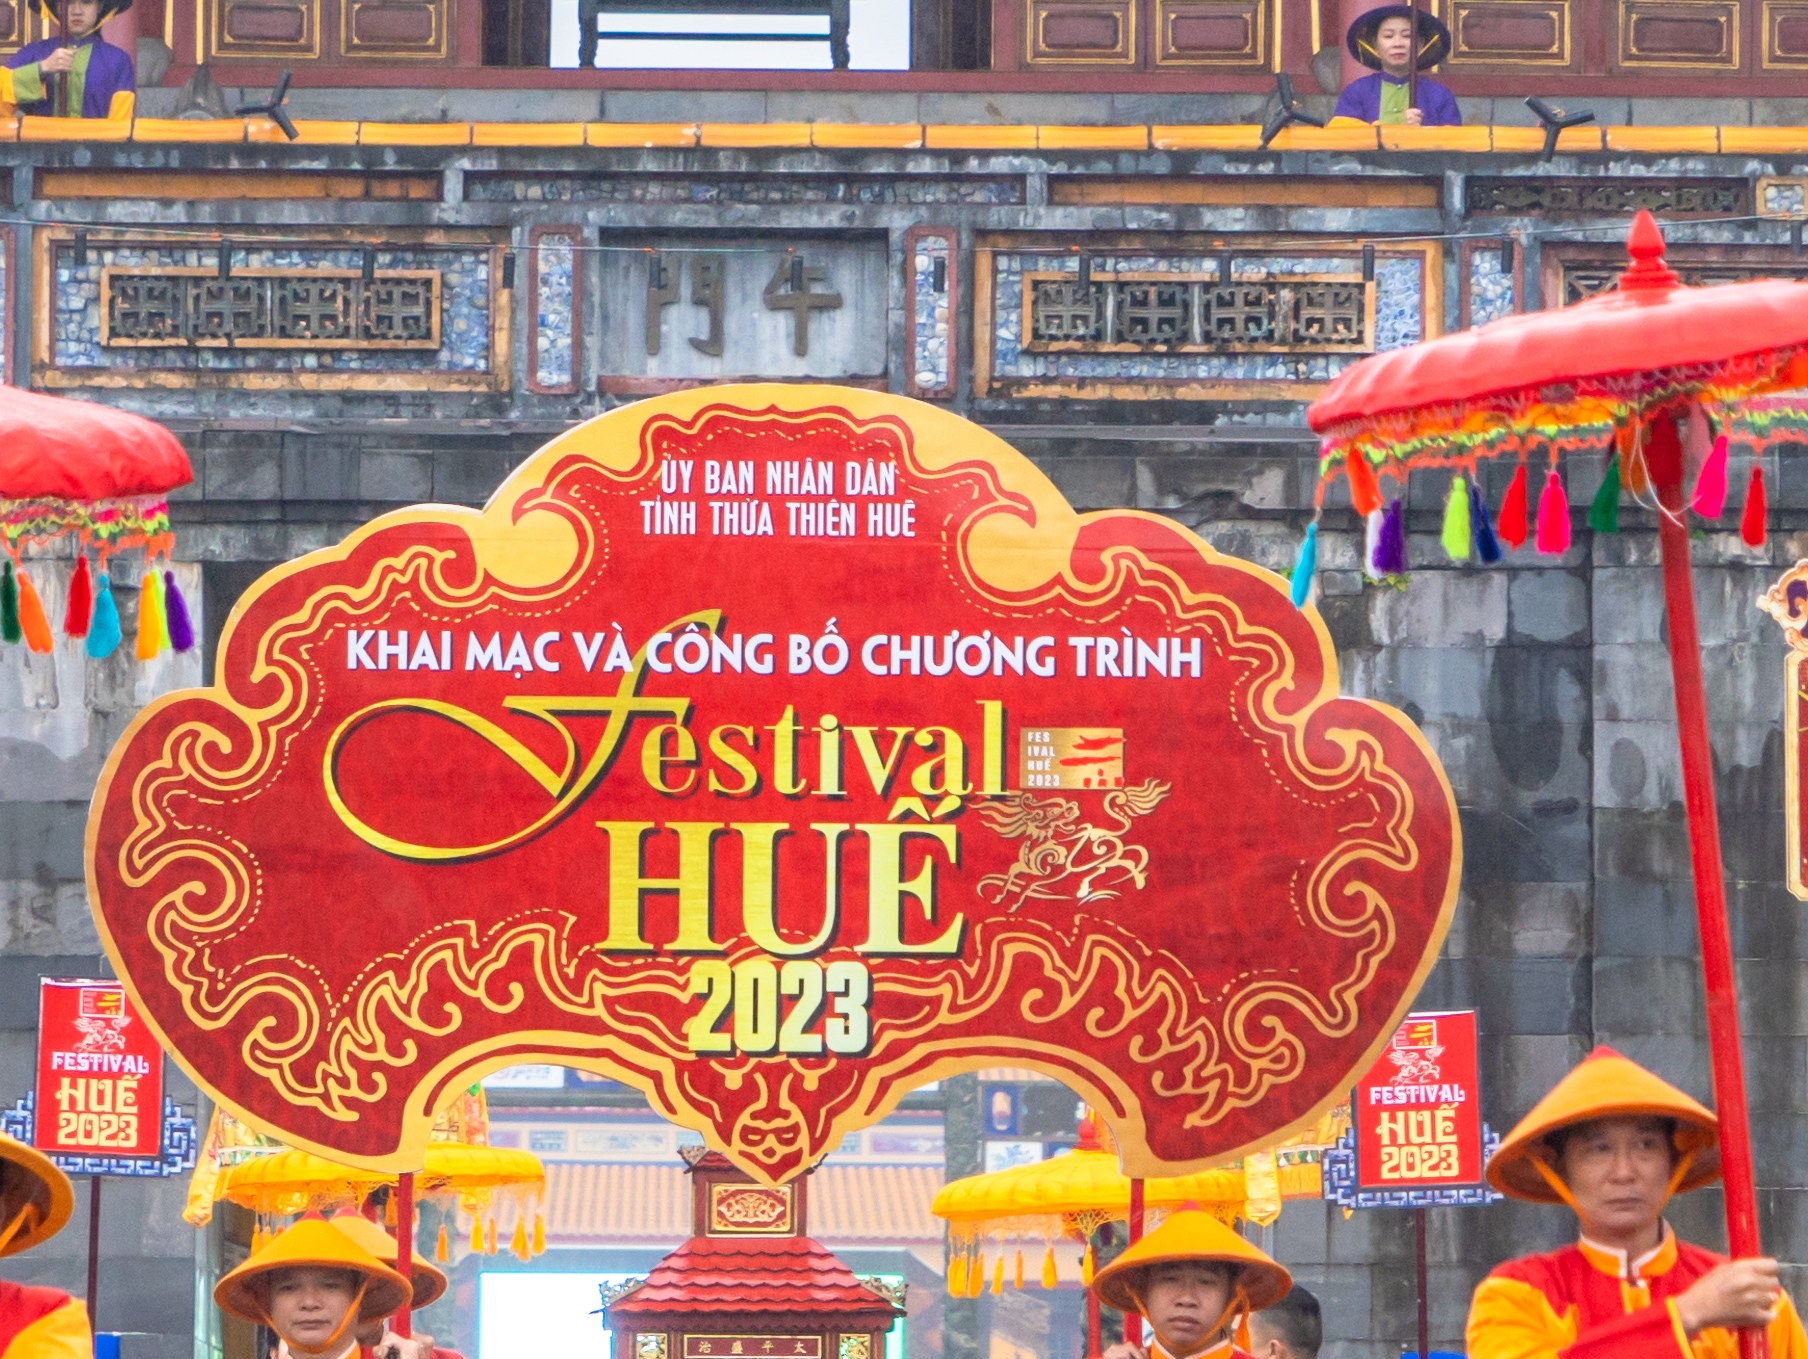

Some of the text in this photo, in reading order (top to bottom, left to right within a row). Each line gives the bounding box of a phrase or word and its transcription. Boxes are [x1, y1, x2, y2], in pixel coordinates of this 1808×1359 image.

[705, 460, 755, 495] BAN
[766, 458, 834, 496] NHÂN
[846, 458, 896, 496] DÂN
[786, 499, 856, 537] THIÊN
[346, 616, 1202, 679] KHAI MẠC VÀ CÔNG BỐ CHƯƠNG TRÌNH
[323, 609, 1009, 862] Festival
[1027, 731, 1051, 743] FES
[1027, 745, 1056, 757] IVAL
[1027, 774, 1060, 787] 2023
[595, 796, 966, 957] HUẾ
[688, 961, 872, 1056] 2023
[52, 1051, 149, 1074] FESTIVAL
[55, 1074, 143, 1114] HUẾ
[1370, 1083, 1465, 1105] FESTIVAL
[57, 1113, 138, 1148] 2023
[1376, 1102, 1460, 1145] HUẾ
[1381, 1144, 1459, 1180] 2023
